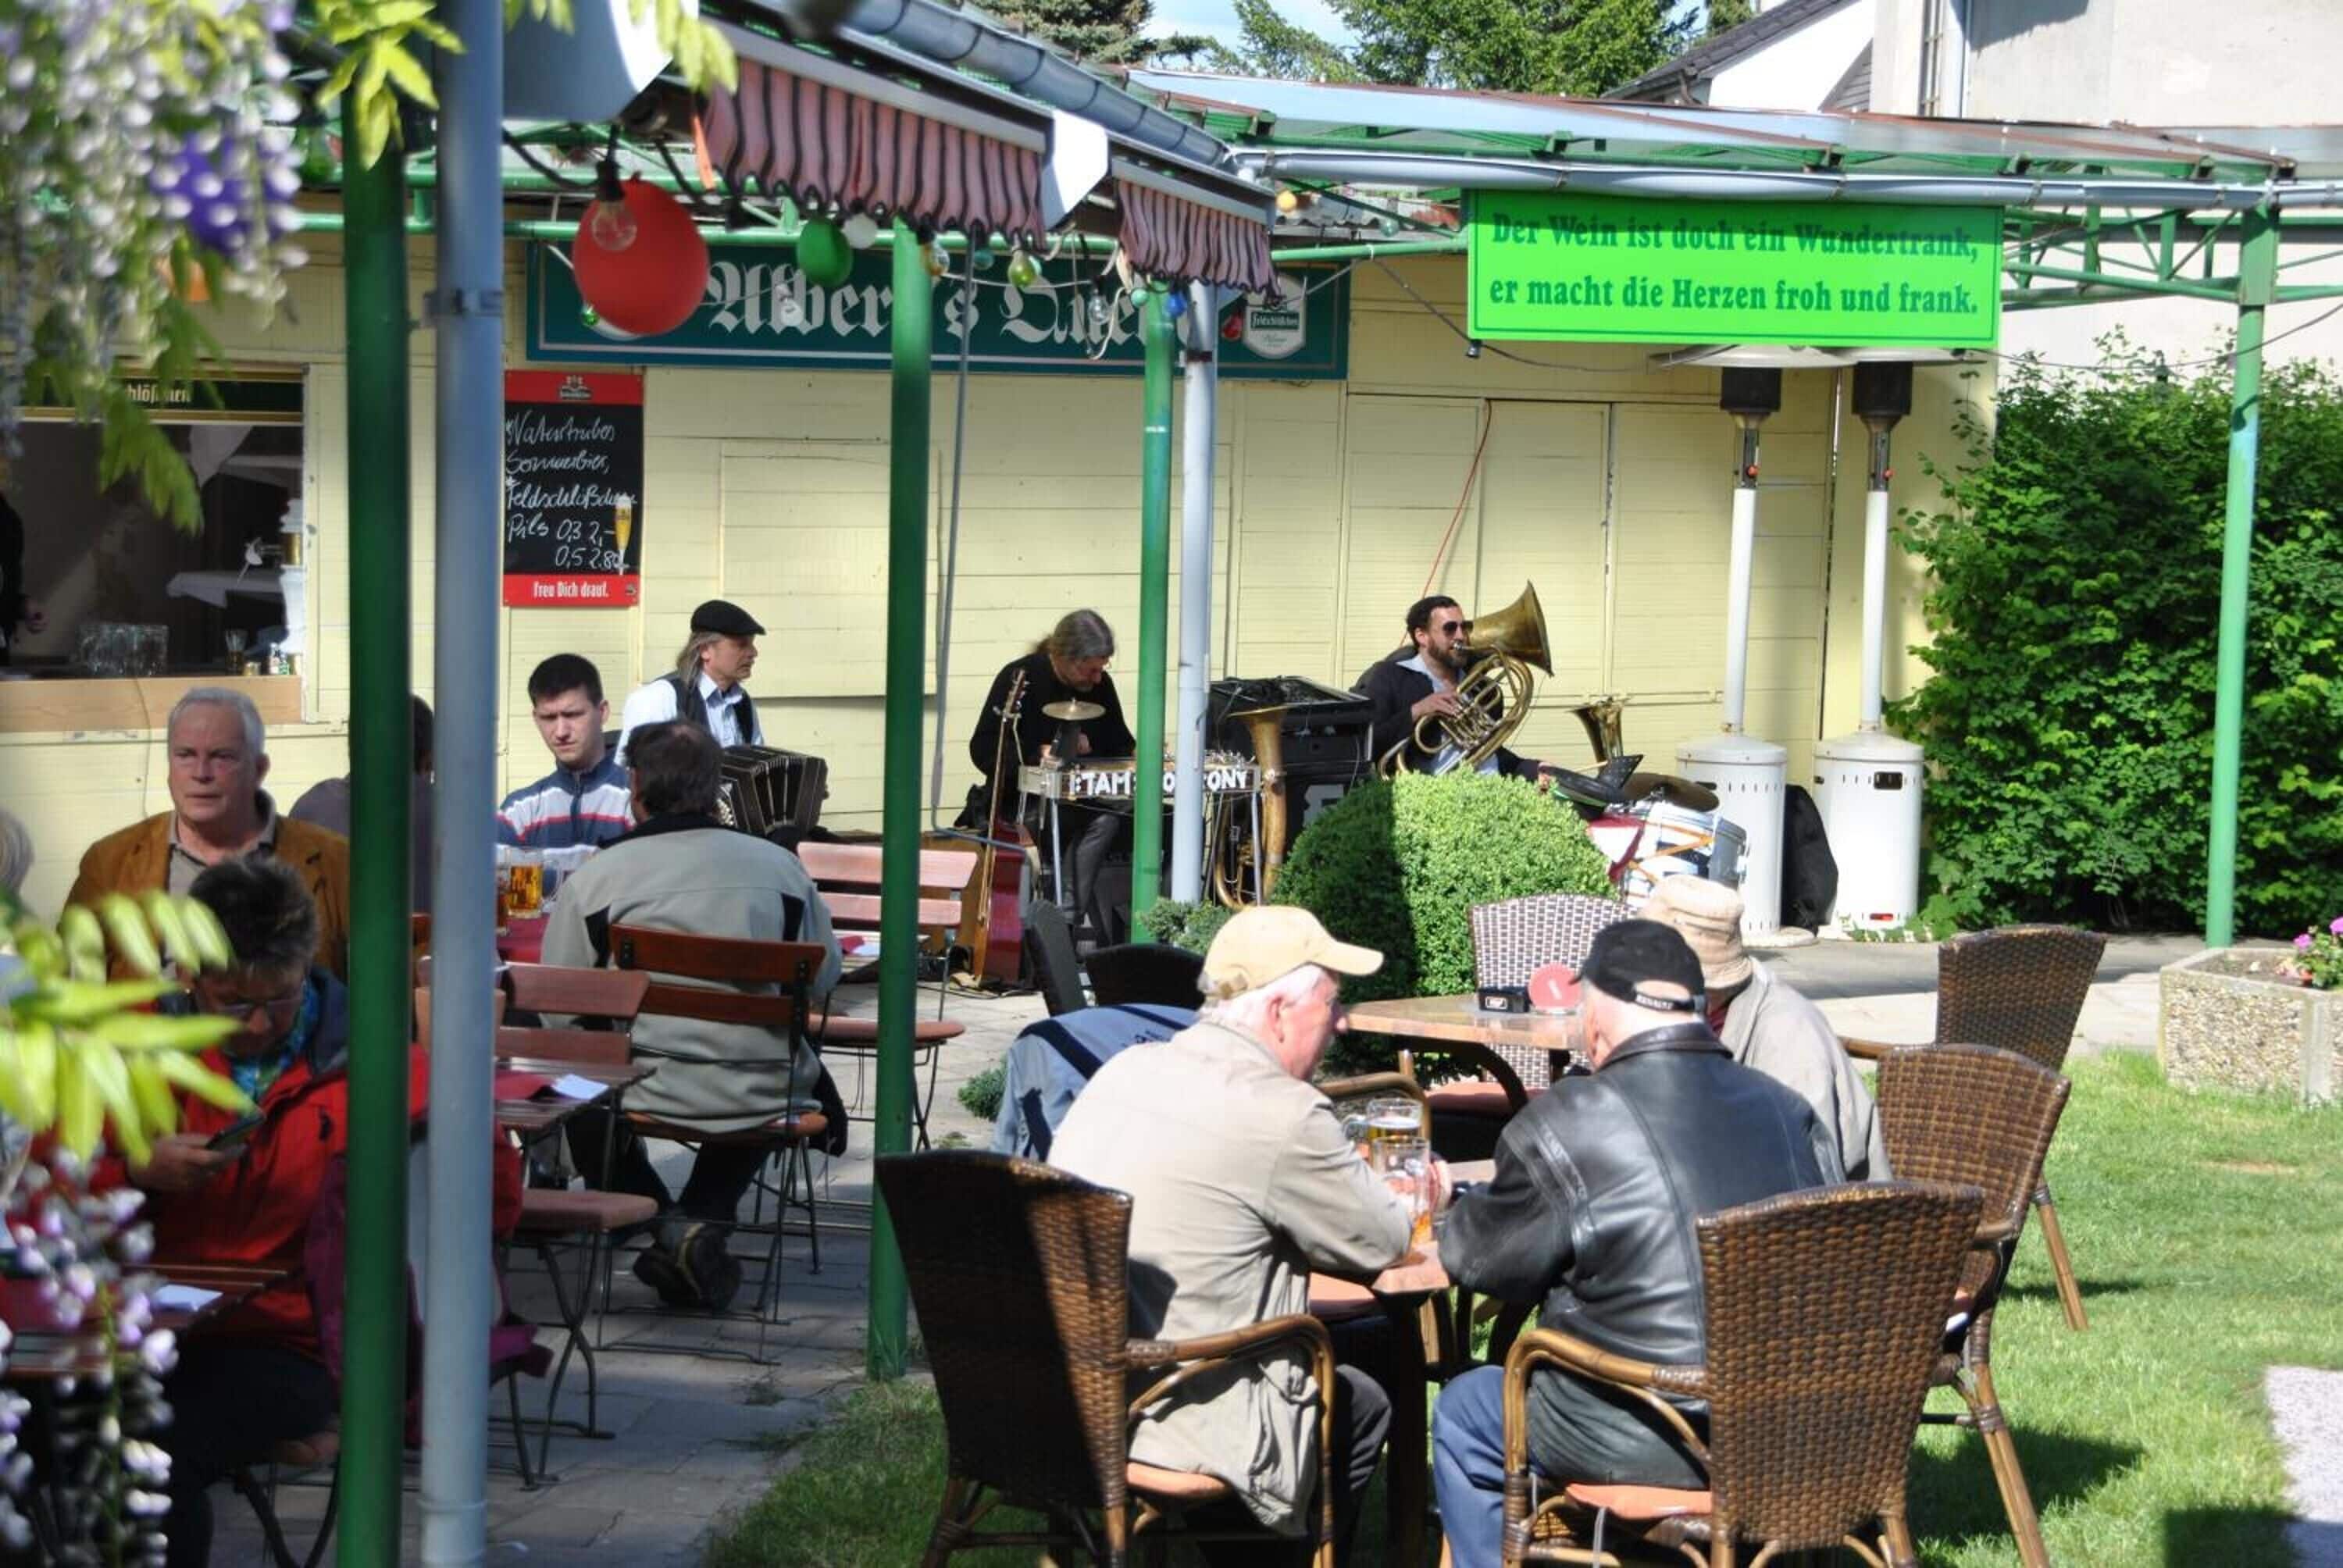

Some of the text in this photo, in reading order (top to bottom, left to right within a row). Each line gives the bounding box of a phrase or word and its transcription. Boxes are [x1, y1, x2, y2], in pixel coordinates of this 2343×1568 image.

[1492, 212, 1978, 263] Der Wein ist doch ein Wundertrank,
[1489, 274, 1978, 314] er macht die Herzen froh und frank.
[508, 512, 549, 543] Pils
[557, 581, 579, 597] Dich
